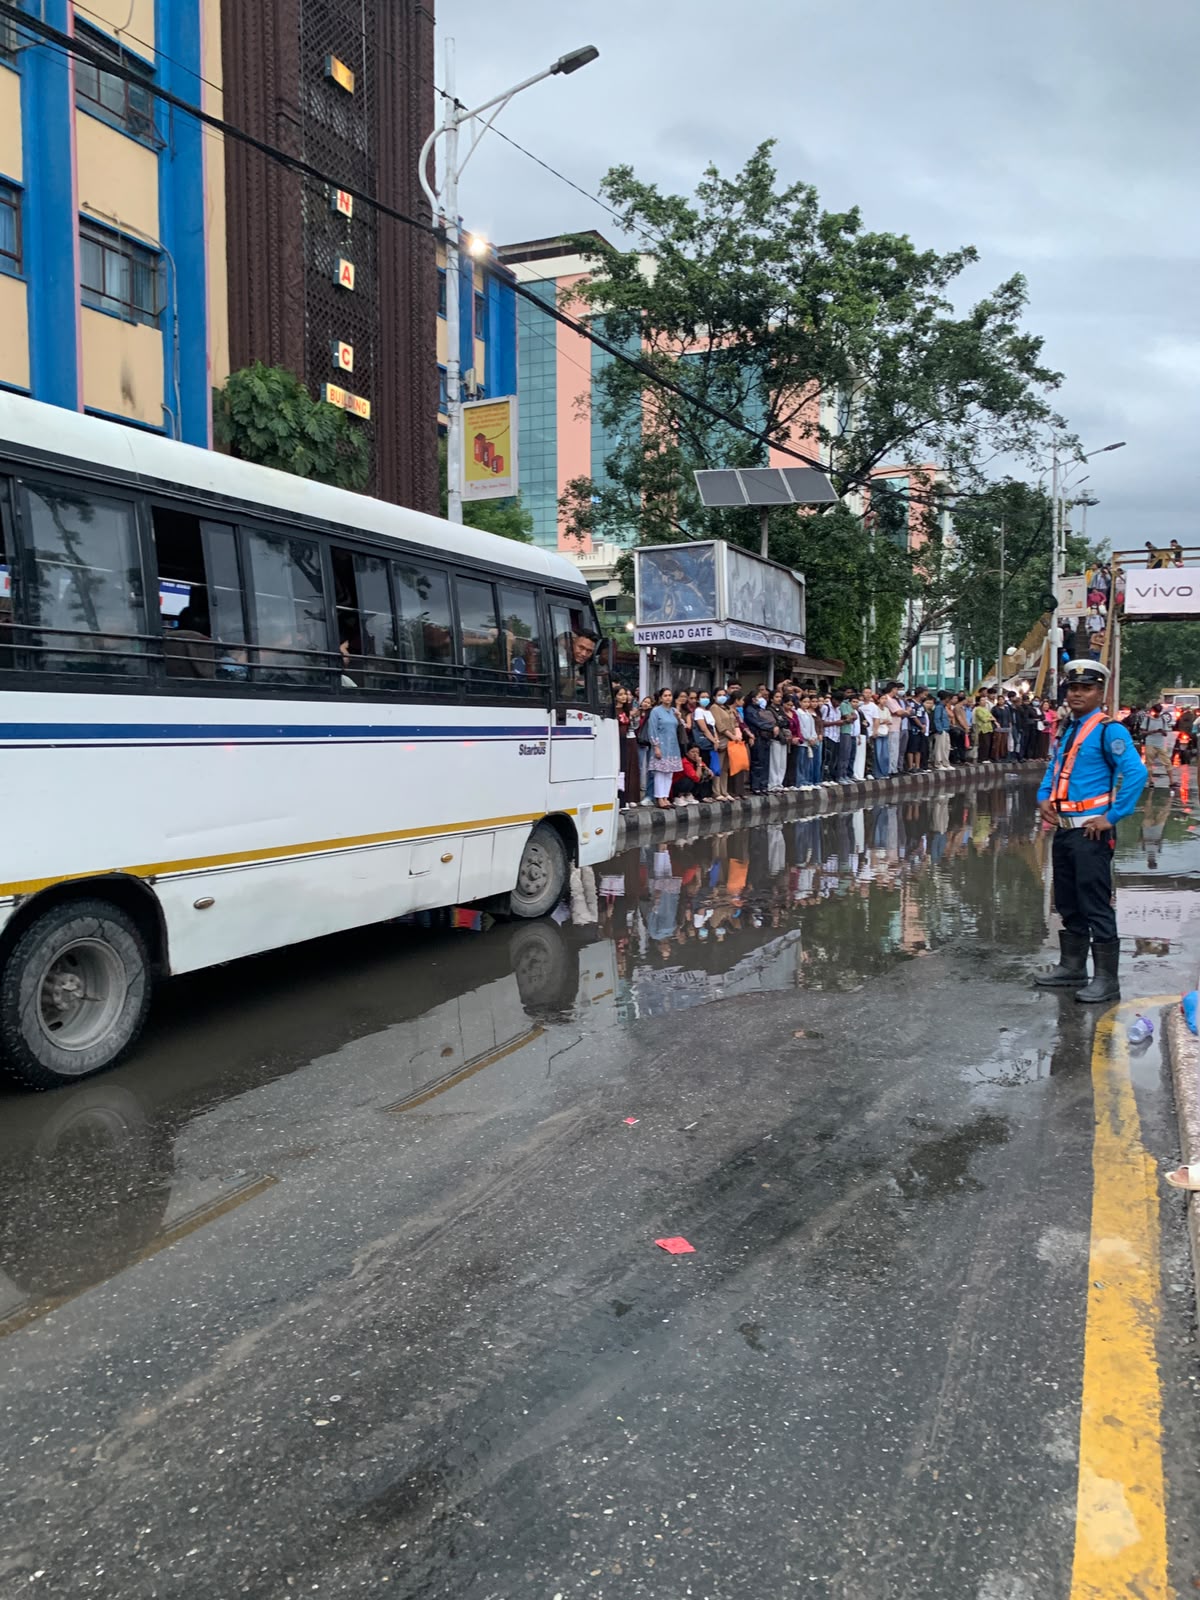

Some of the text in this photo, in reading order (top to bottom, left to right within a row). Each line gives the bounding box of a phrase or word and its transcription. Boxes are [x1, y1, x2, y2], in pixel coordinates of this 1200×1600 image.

[330, 388, 367, 415] BUILDING
[1135, 584, 1193, 597] vivo
[638, 627, 713, 641] NEWROAD GATE
[519, 743, 546, 756] Starbus
